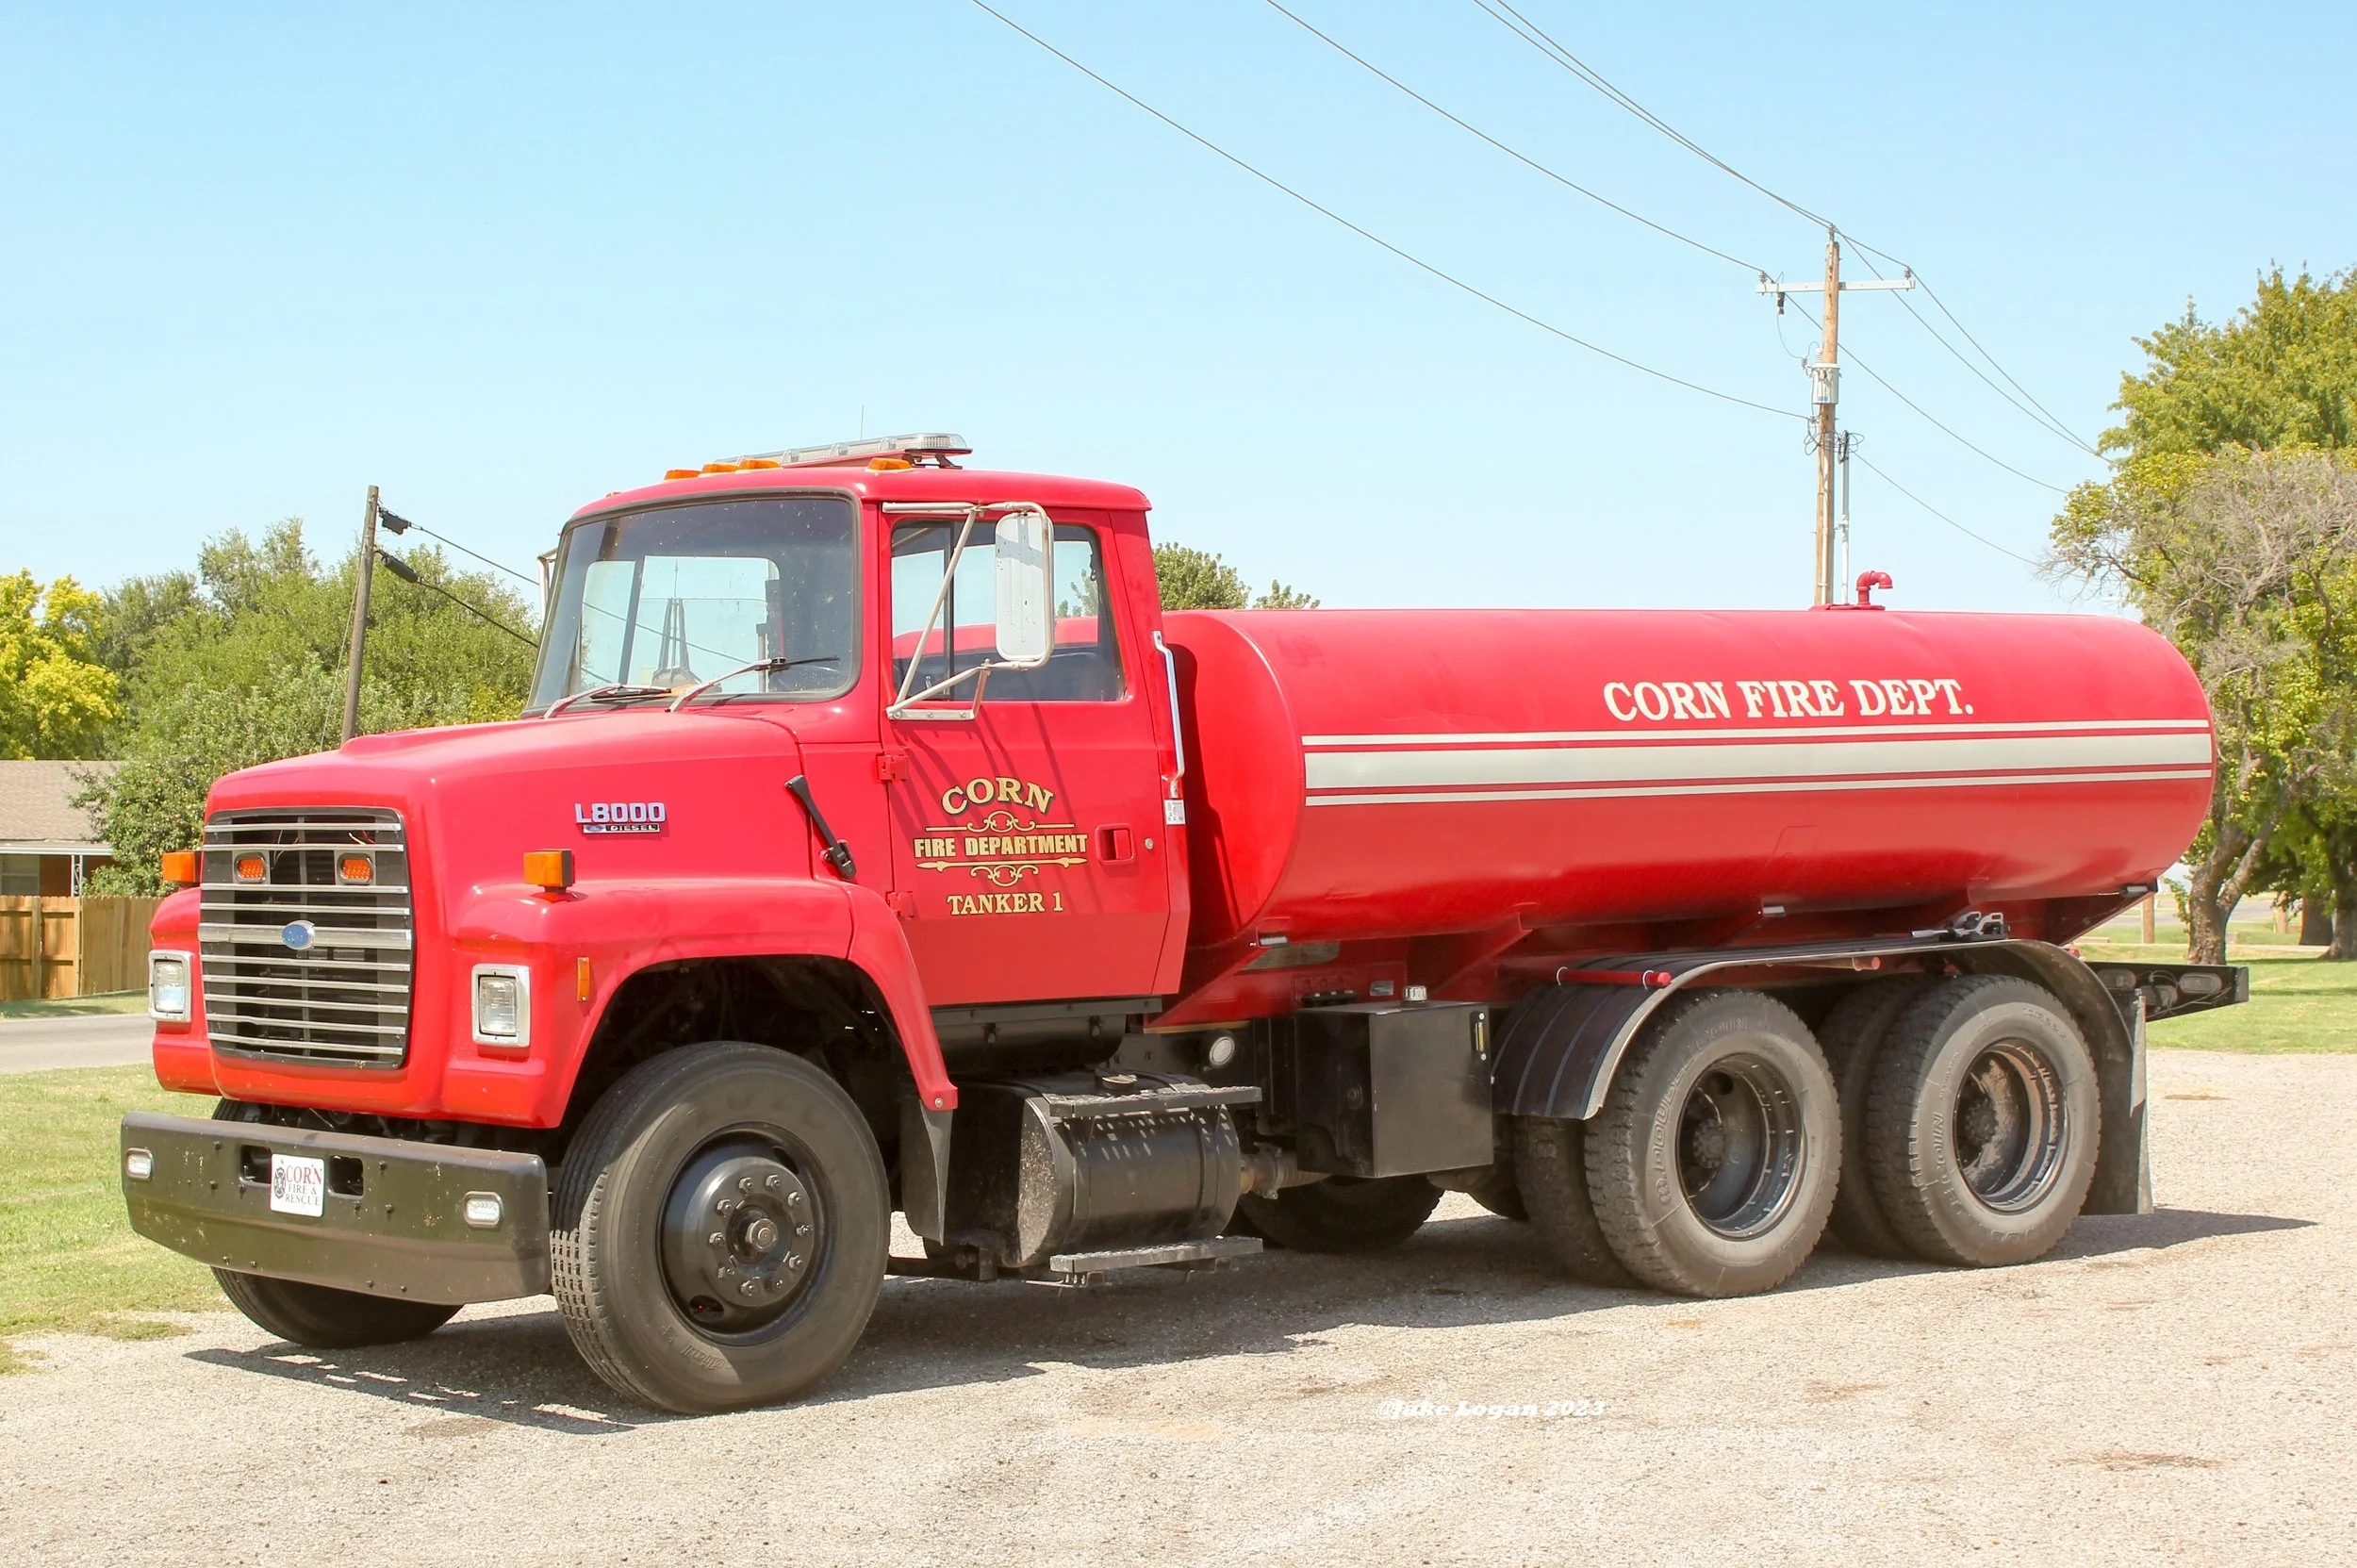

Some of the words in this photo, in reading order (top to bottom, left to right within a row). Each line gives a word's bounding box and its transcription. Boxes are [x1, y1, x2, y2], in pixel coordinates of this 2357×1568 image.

[1604, 682, 1731, 721] CORN
[1737, 680, 1845, 718] FIRE
[1849, 679, 1974, 716] DEPT.
[942, 776, 1054, 815] CORN
[574, 801, 666, 823] L8000
[914, 838, 956, 858] FIRE
[964, 834, 1088, 856] DEPARTMENT
[947, 893, 1046, 916] TANKER
[1053, 892, 1063, 912] 1
[286, 1165, 321, 1184] CORN
[285, 1194, 321, 1205] RESCUE
[288, 1183, 307, 1194] FIRE
[311, 1186, 318, 1195] &
